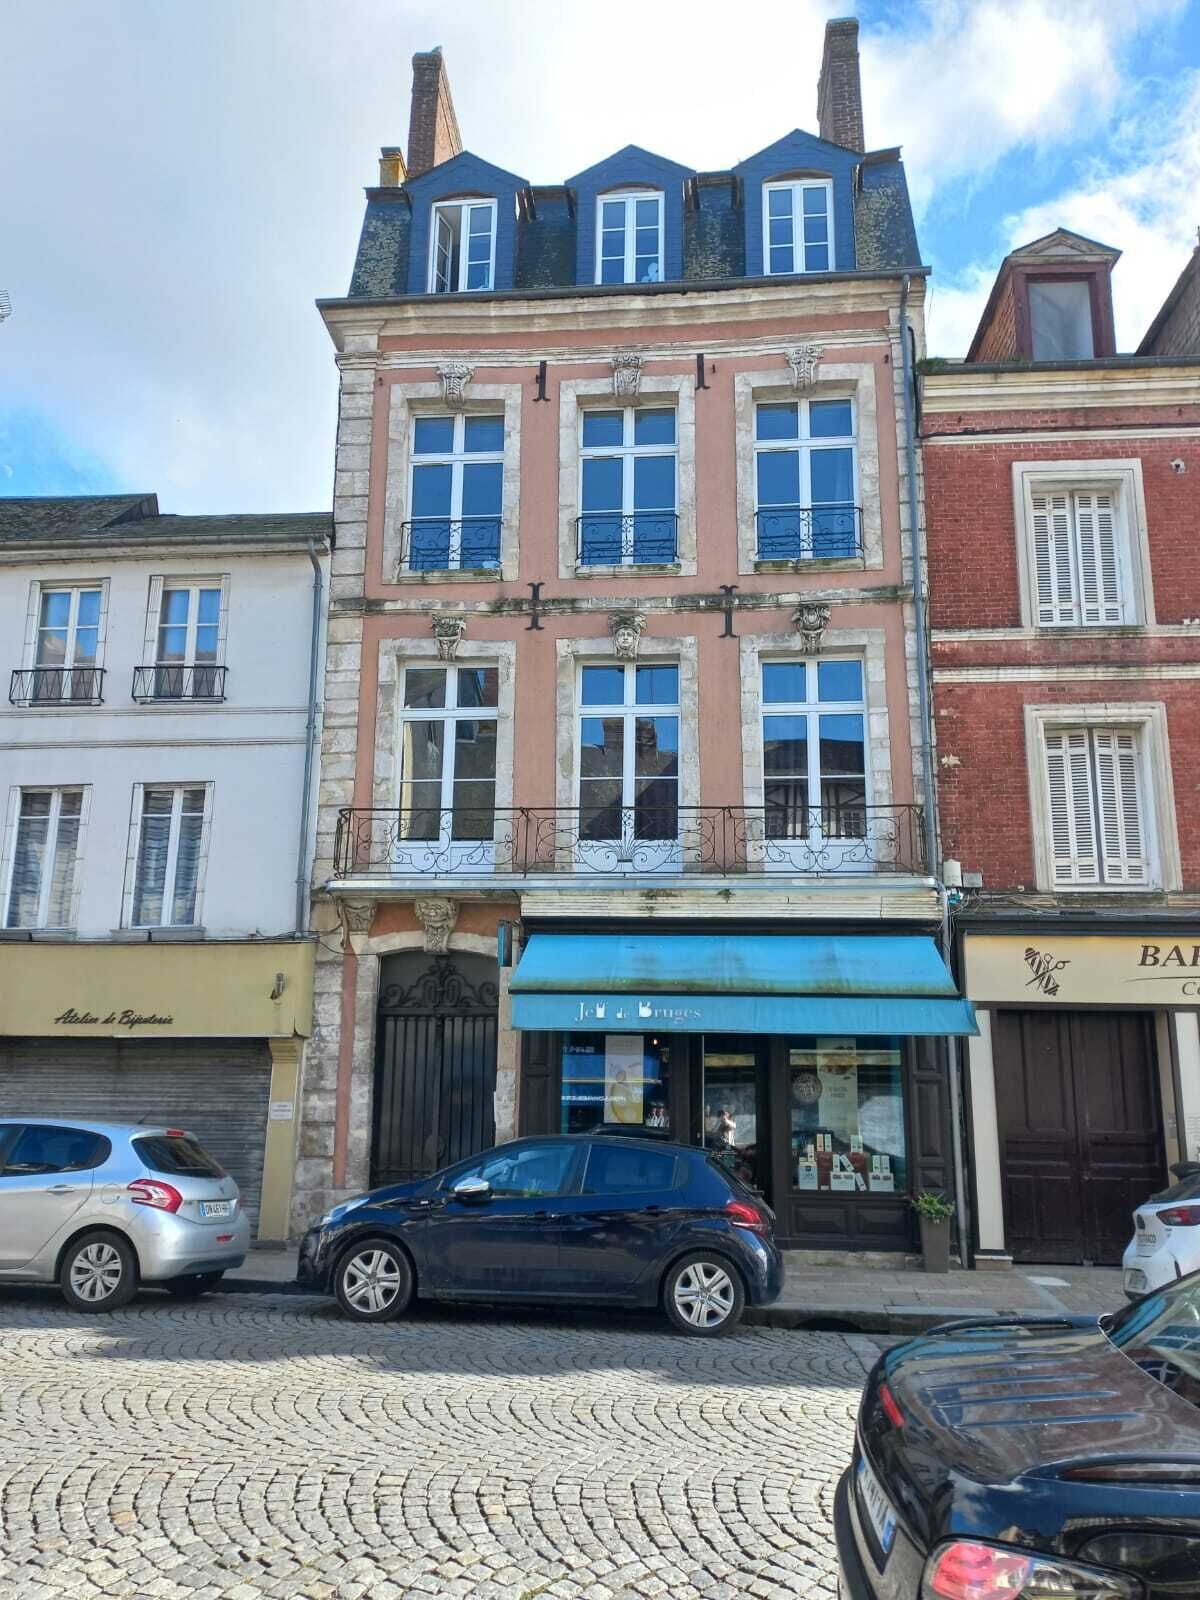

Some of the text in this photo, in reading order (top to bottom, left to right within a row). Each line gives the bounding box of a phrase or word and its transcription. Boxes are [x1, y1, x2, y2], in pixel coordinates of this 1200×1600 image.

[54, 1007, 175, 1030] Atelier de Bijouterie
[638, 999, 702, 1025] Bruges
